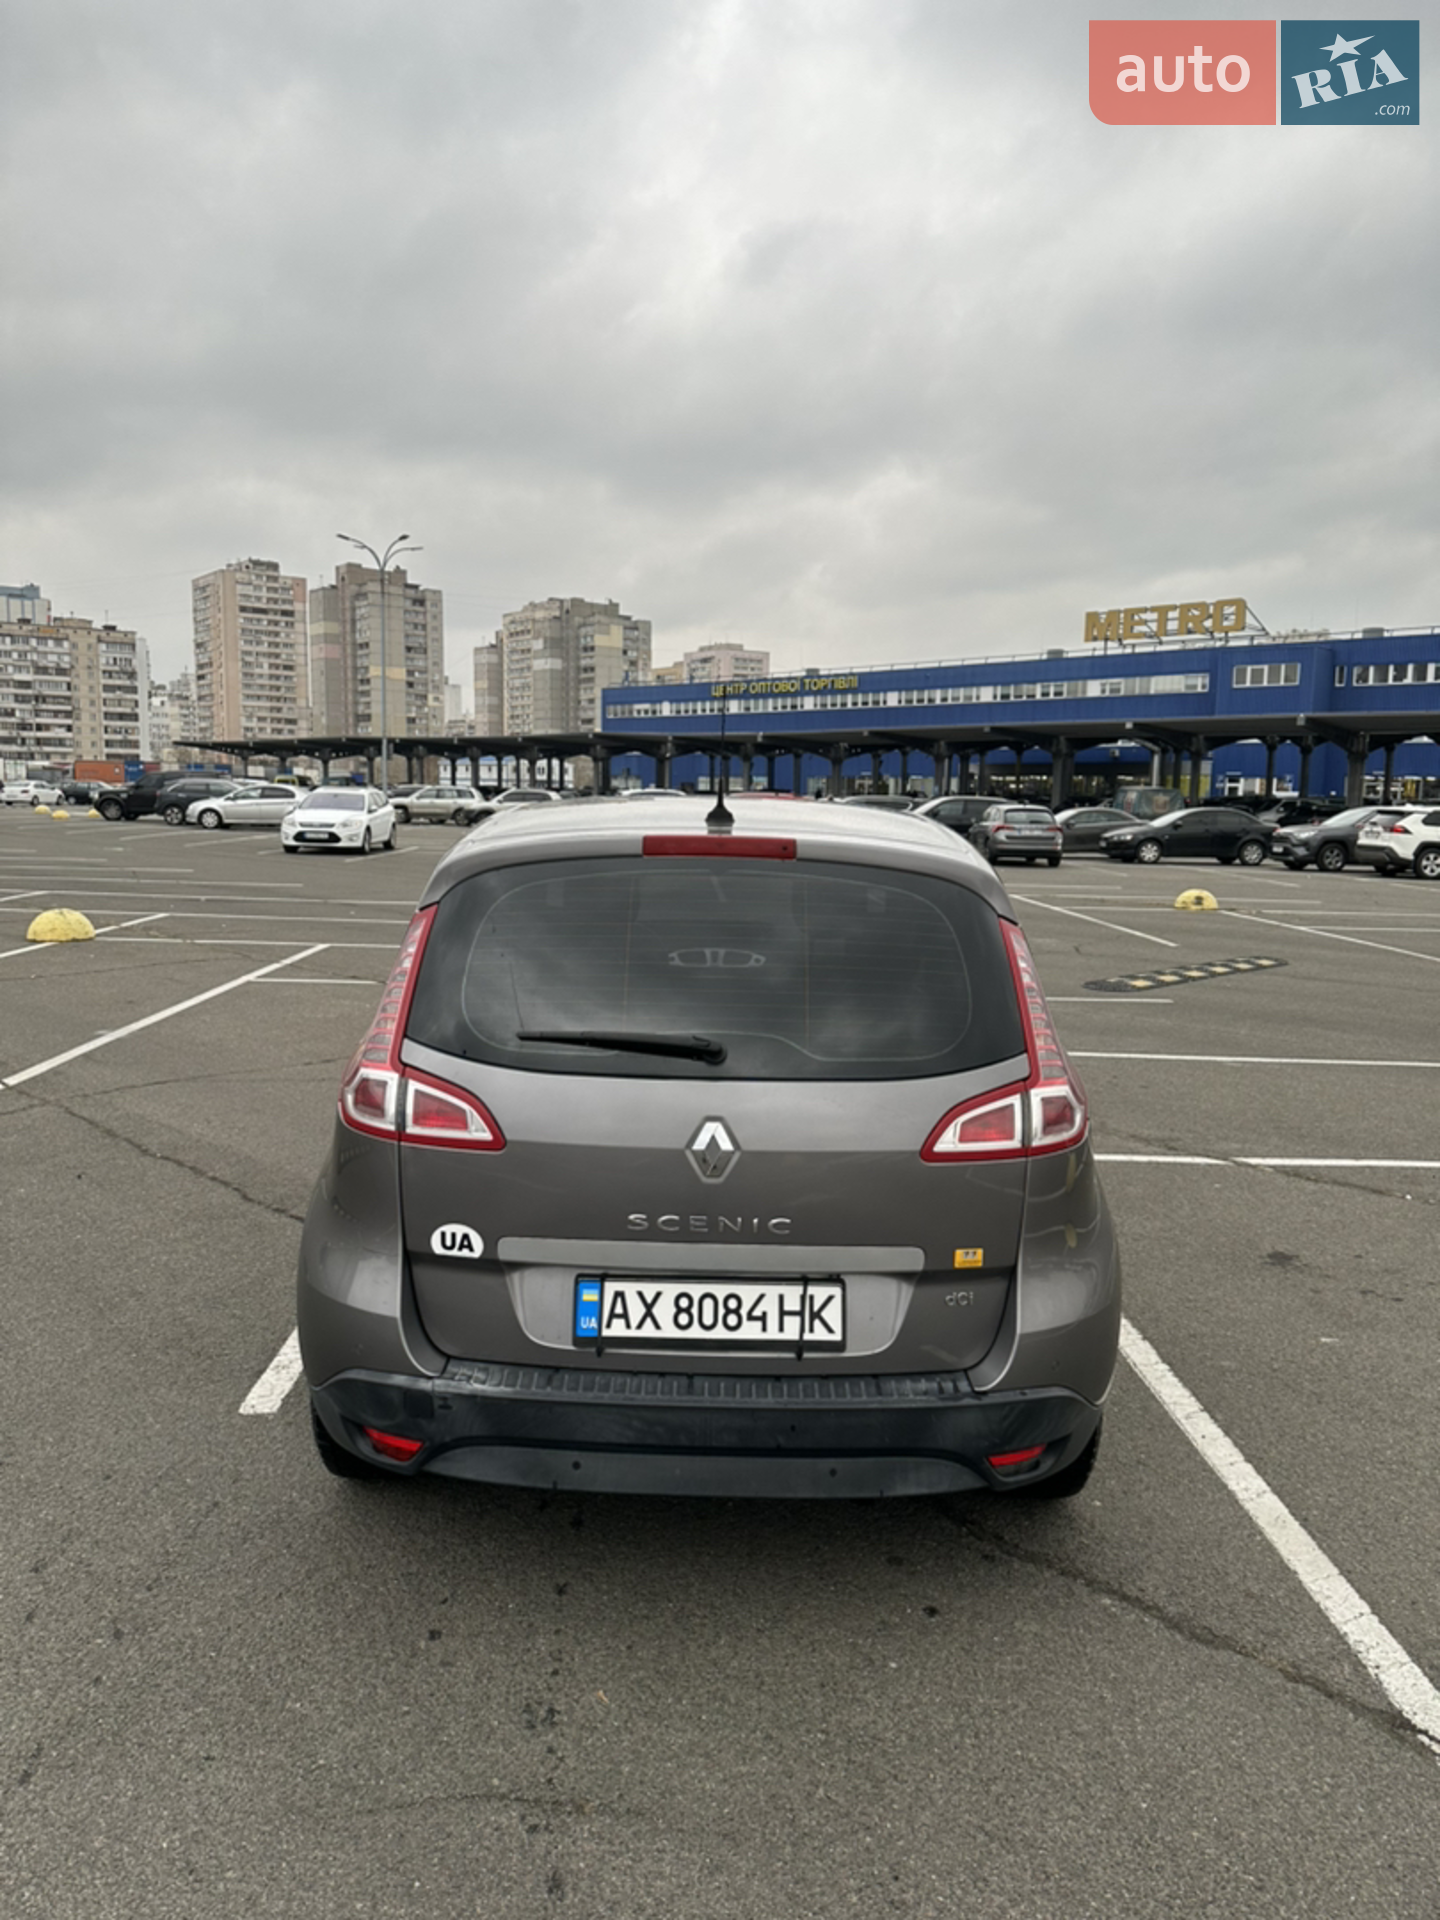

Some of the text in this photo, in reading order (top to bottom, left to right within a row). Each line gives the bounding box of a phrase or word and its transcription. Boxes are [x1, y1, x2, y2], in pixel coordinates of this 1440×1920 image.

[1084, 597, 1246, 642] METRO
[711, 675, 858, 697] ЦЕНТР ОПТОВОЇ ТОРГІВЛІ
[626, 1213, 792, 1235] SCENIC
[440, 1230, 475, 1253] UA
[945, 1291, 974, 1306] dCi
[580, 1316, 598, 1330] UA
[605, 1290, 836, 1335] AX 8084 HK
